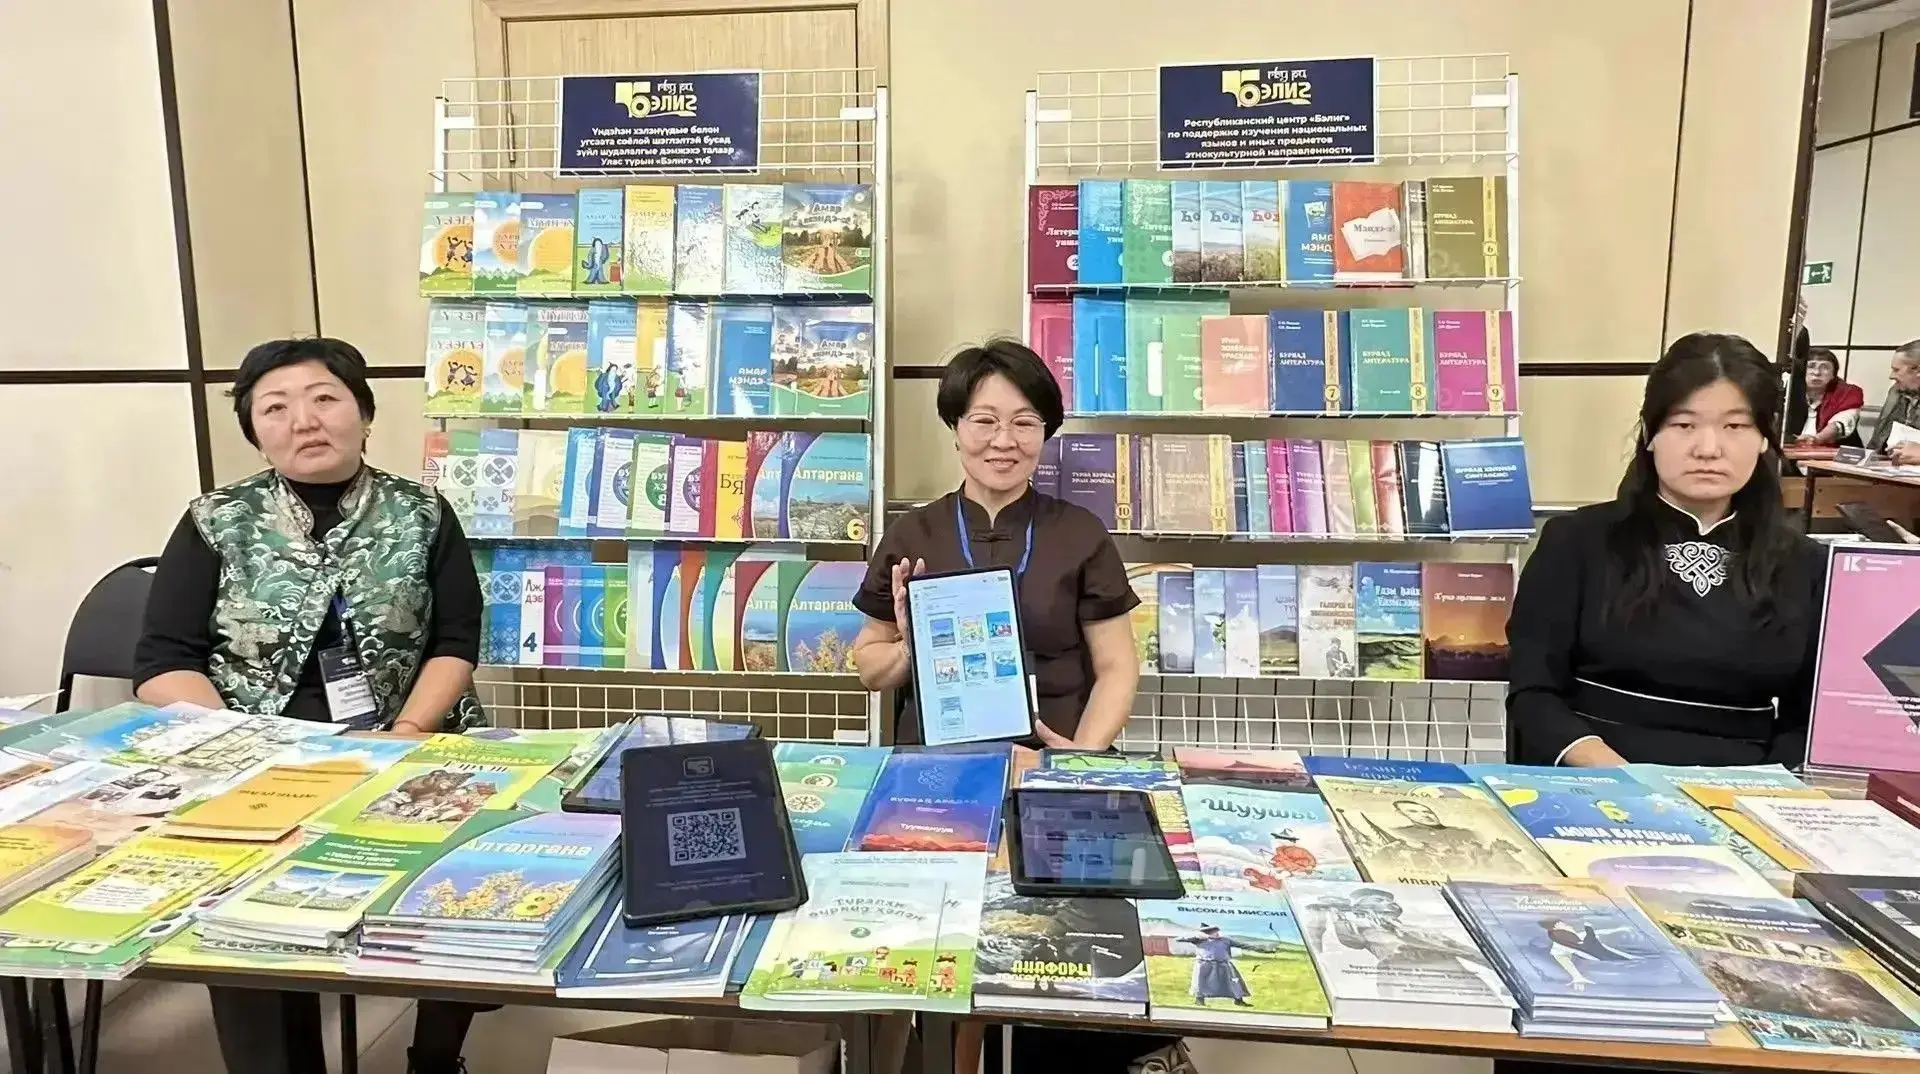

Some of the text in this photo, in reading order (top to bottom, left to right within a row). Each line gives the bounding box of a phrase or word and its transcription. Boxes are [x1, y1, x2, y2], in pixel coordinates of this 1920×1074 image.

[1184, 114, 1350, 128] Республиканский центр «Бэлиг»
[690, 125, 720, 134] болон
[1182, 128, 1239, 139] поддержке
[1241, 127, 1290, 137] изучения
[1291, 124, 1367, 134] национальных
[703, 135, 731, 146] бусад
[1201, 136, 1333, 148] языков и иных предметов
[1184, 146, 1352, 159] этнокультурной направленности
[794, 468, 863, 482] Алтаргана
[1118, 506, 1130, 516] 10
[847, 519, 865, 540] 6
[523, 632, 537, 652] 4
[461, 838, 593, 857] Алтаргана
[512, 893, 554, 917] 8
[1177, 906, 1236, 915] ВЫСОКАЯ
[1011, 960, 1092, 977] АНАФОРЫ
